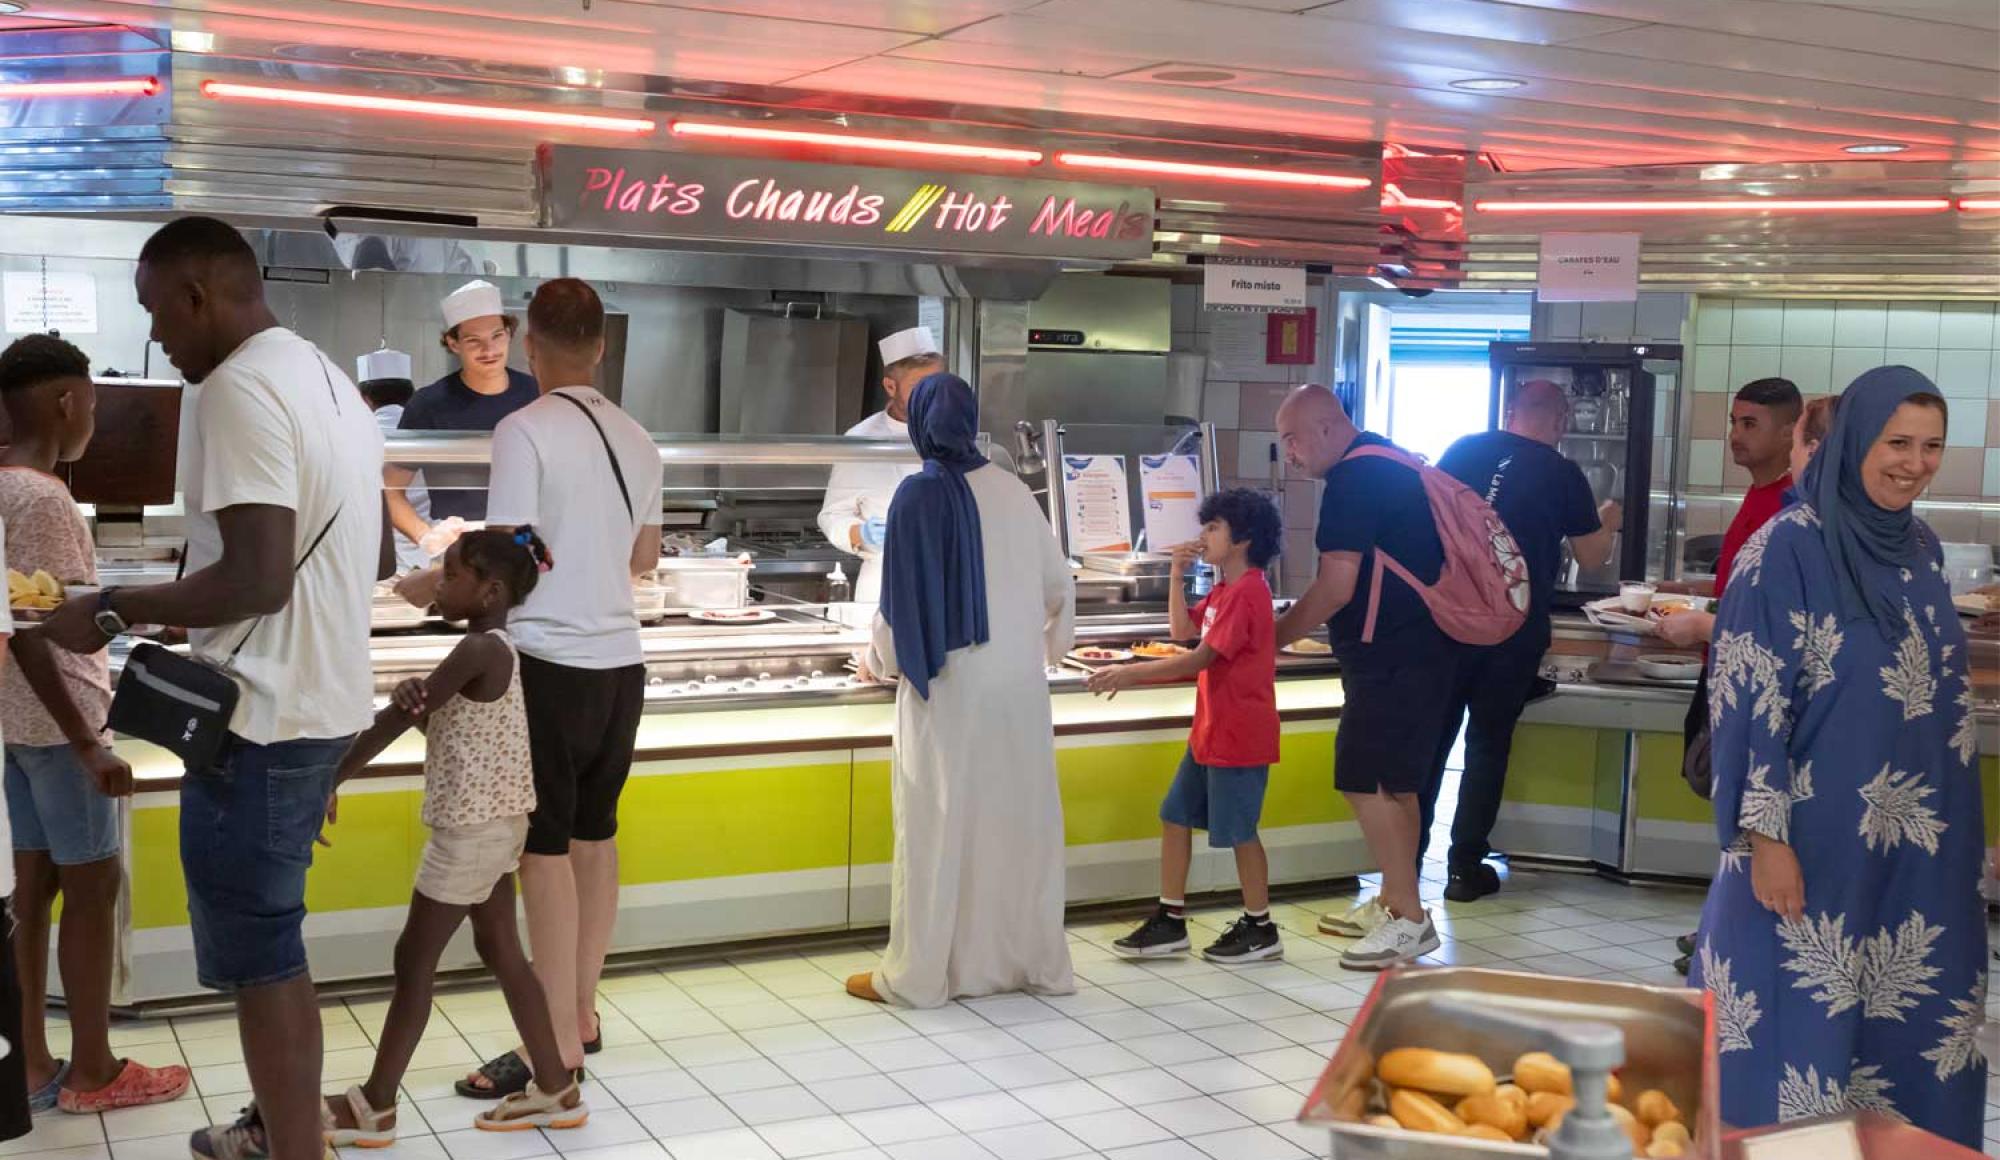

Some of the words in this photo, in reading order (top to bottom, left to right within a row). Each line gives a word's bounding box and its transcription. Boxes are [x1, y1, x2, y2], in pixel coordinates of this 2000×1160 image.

[584, 167, 704, 214] Plats
[726, 178, 884, 225] Chauds
[935, 192, 1013, 231] Hot
[1031, 196, 1145, 240] Meals
[1231, 279, 1252, 289] Frito
[1254, 280, 1281, 291] misto
